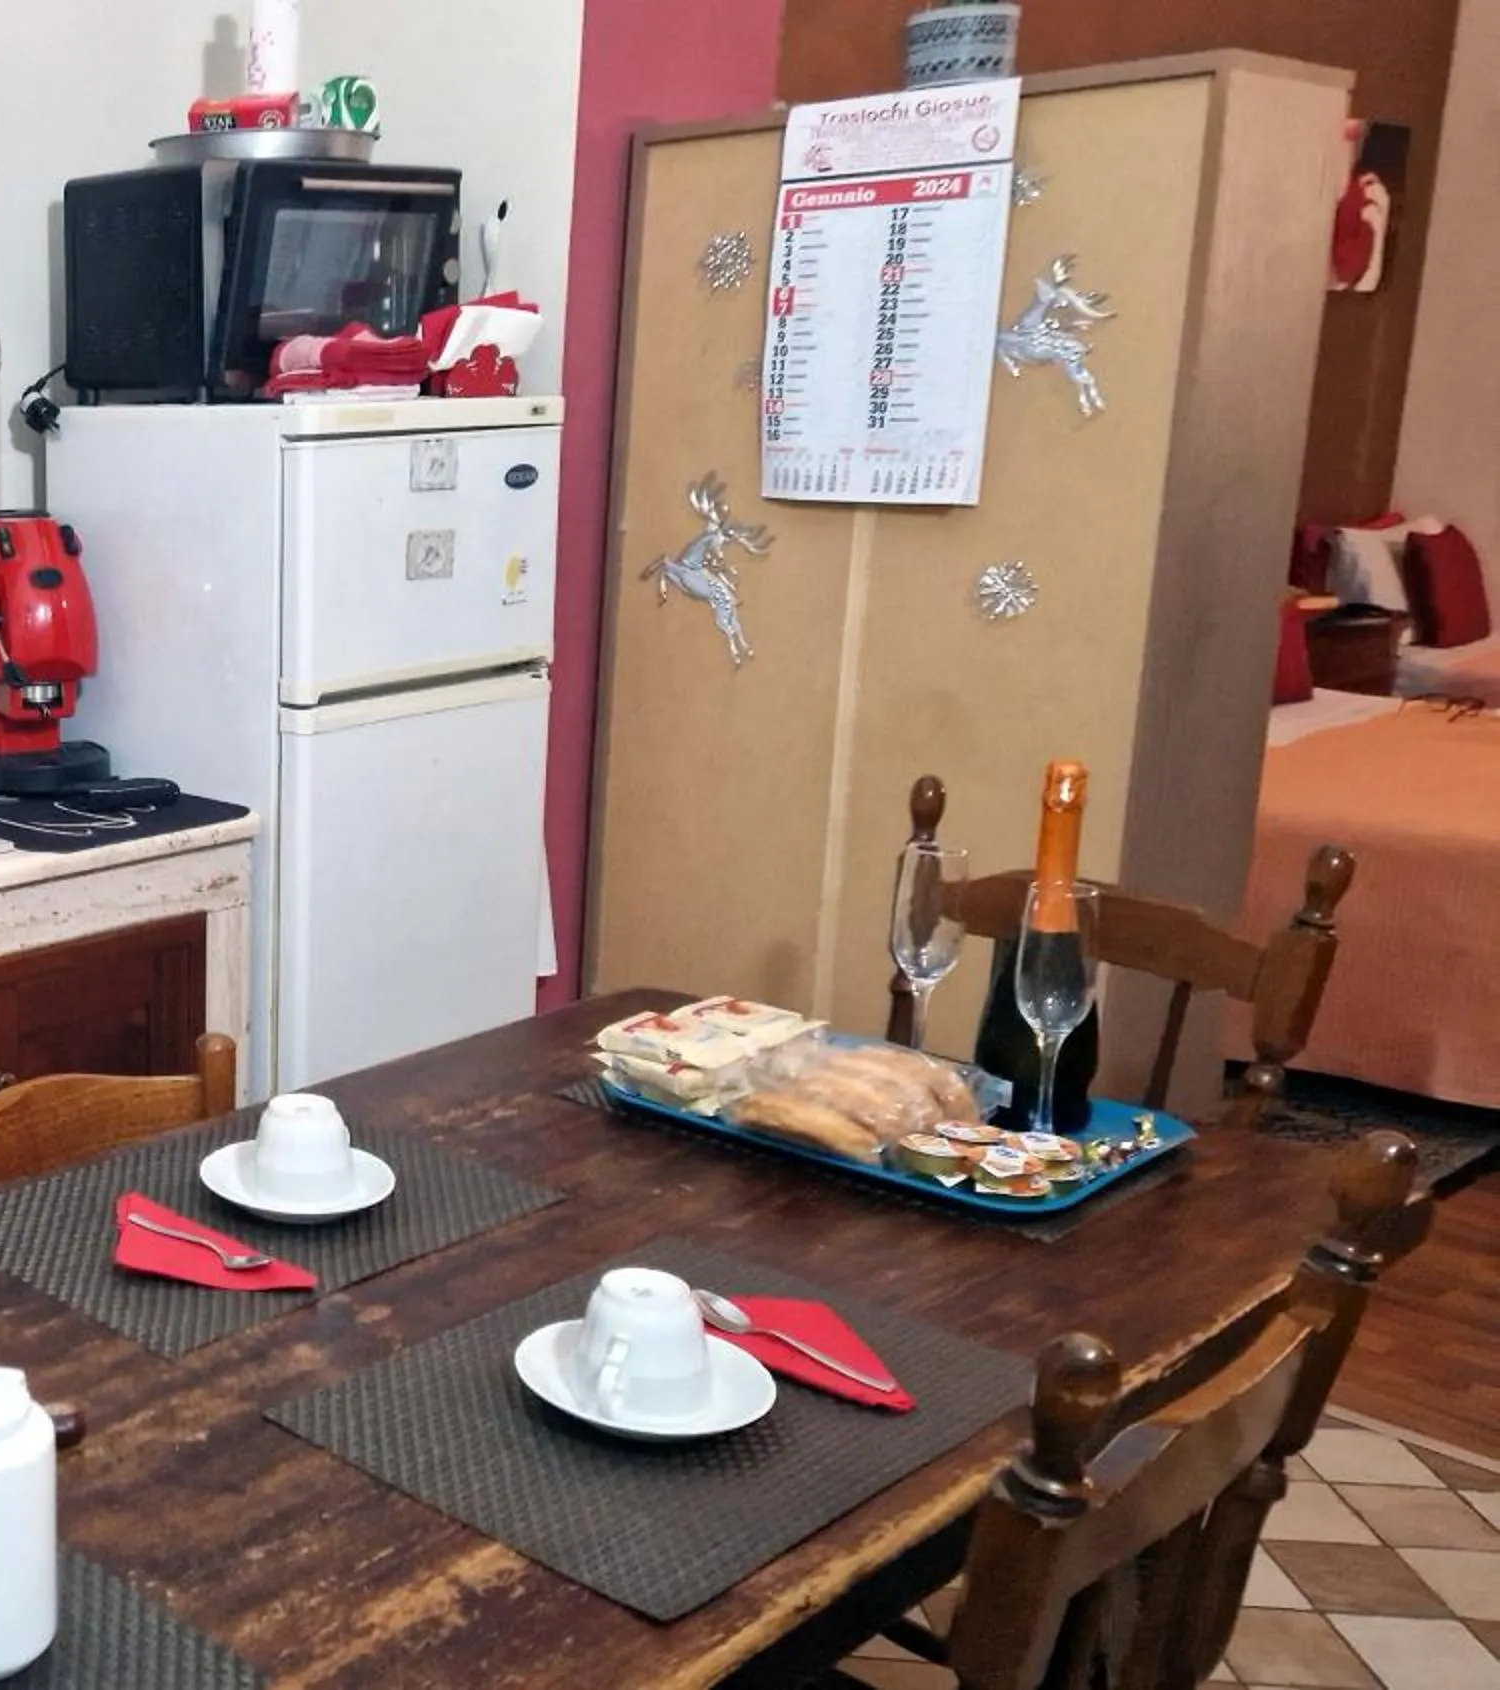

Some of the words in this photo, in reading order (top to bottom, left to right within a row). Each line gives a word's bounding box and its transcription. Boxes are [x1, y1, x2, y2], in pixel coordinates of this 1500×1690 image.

[819, 101, 909, 126] Traslochi
[913, 177, 962, 197] 2024
[791, 187, 877, 208] Gennaio
[891, 208, 909, 220] 17
[889, 223, 907, 236] 18
[888, 238, 906, 250] 19
[885, 253, 904, 265] 20
[881, 283, 900, 296] 22
[879, 298, 898, 311] 23
[877, 313, 897, 326] 24
[876, 328, 895, 341] 25
[772, 345, 788, 357] 10
[771, 360, 786, 371] 11
[873, 357, 892, 369] 27
[770, 374, 785, 385] 12
[768, 388, 783, 399] 13
[870, 387, 889, 399] 29
[869, 401, 887, 414] 30
[767, 416, 781, 427] 15
[867, 416, 885, 429] 31
